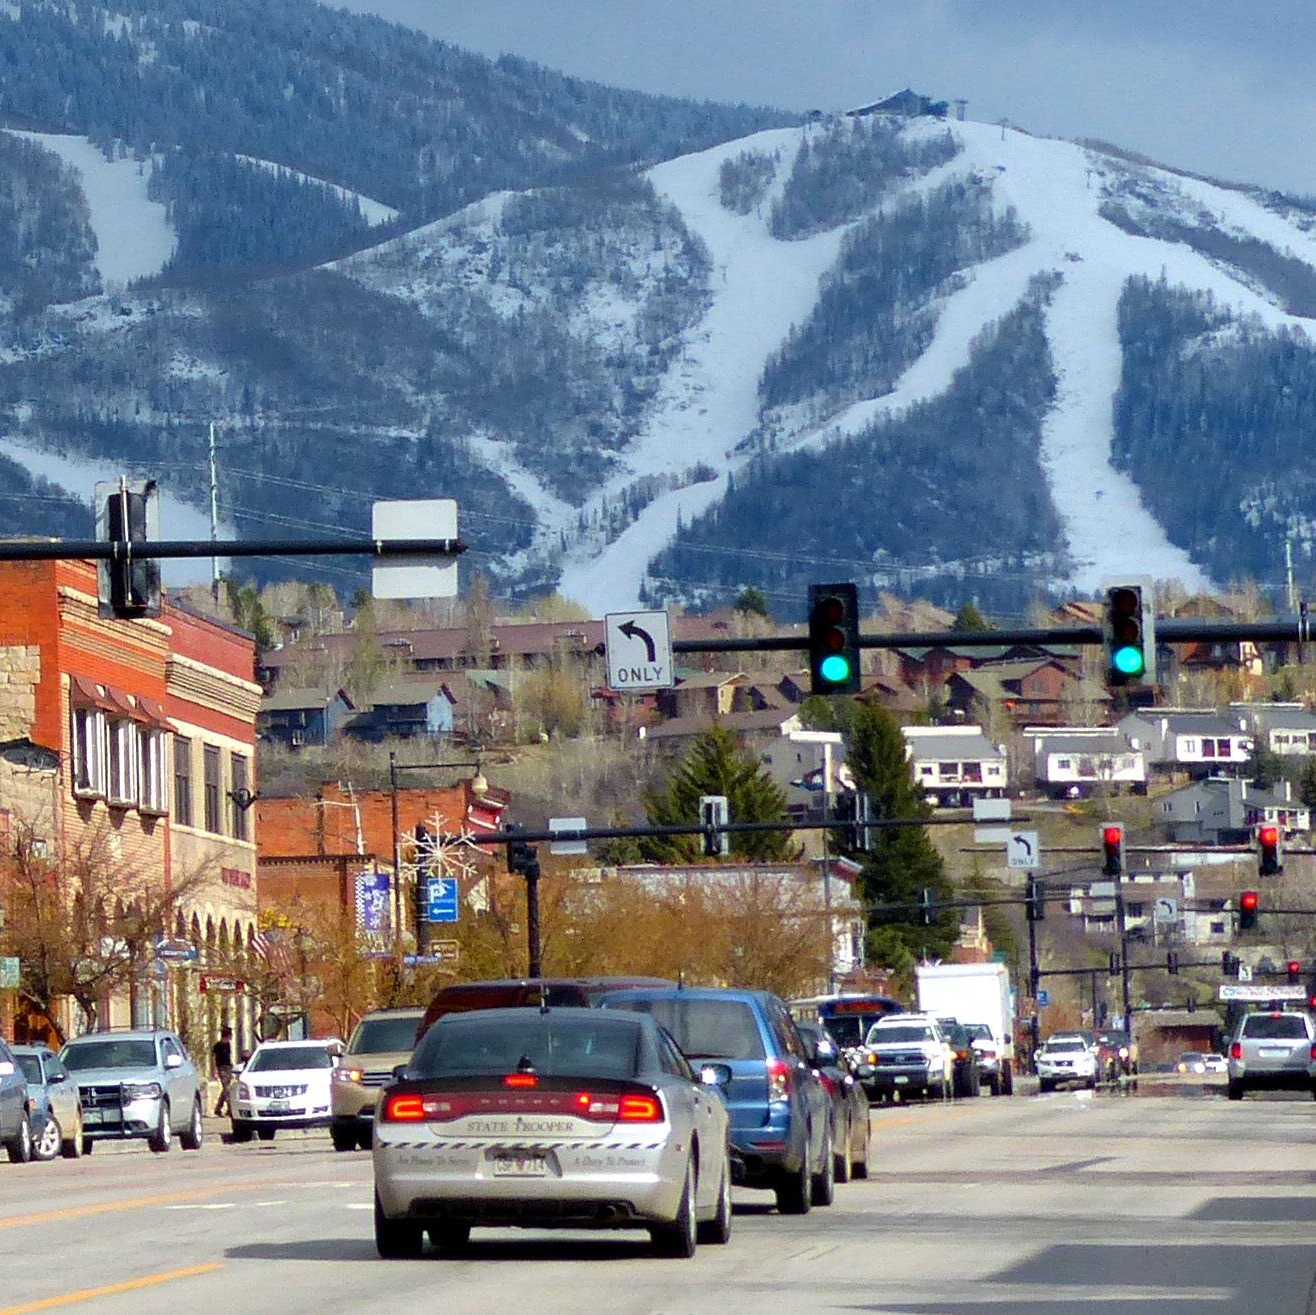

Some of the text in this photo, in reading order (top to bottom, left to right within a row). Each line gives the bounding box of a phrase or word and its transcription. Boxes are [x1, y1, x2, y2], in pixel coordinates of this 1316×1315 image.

[618, 668, 662, 683] ONLY
[467, 1121, 574, 1132] STATE TROOPER
